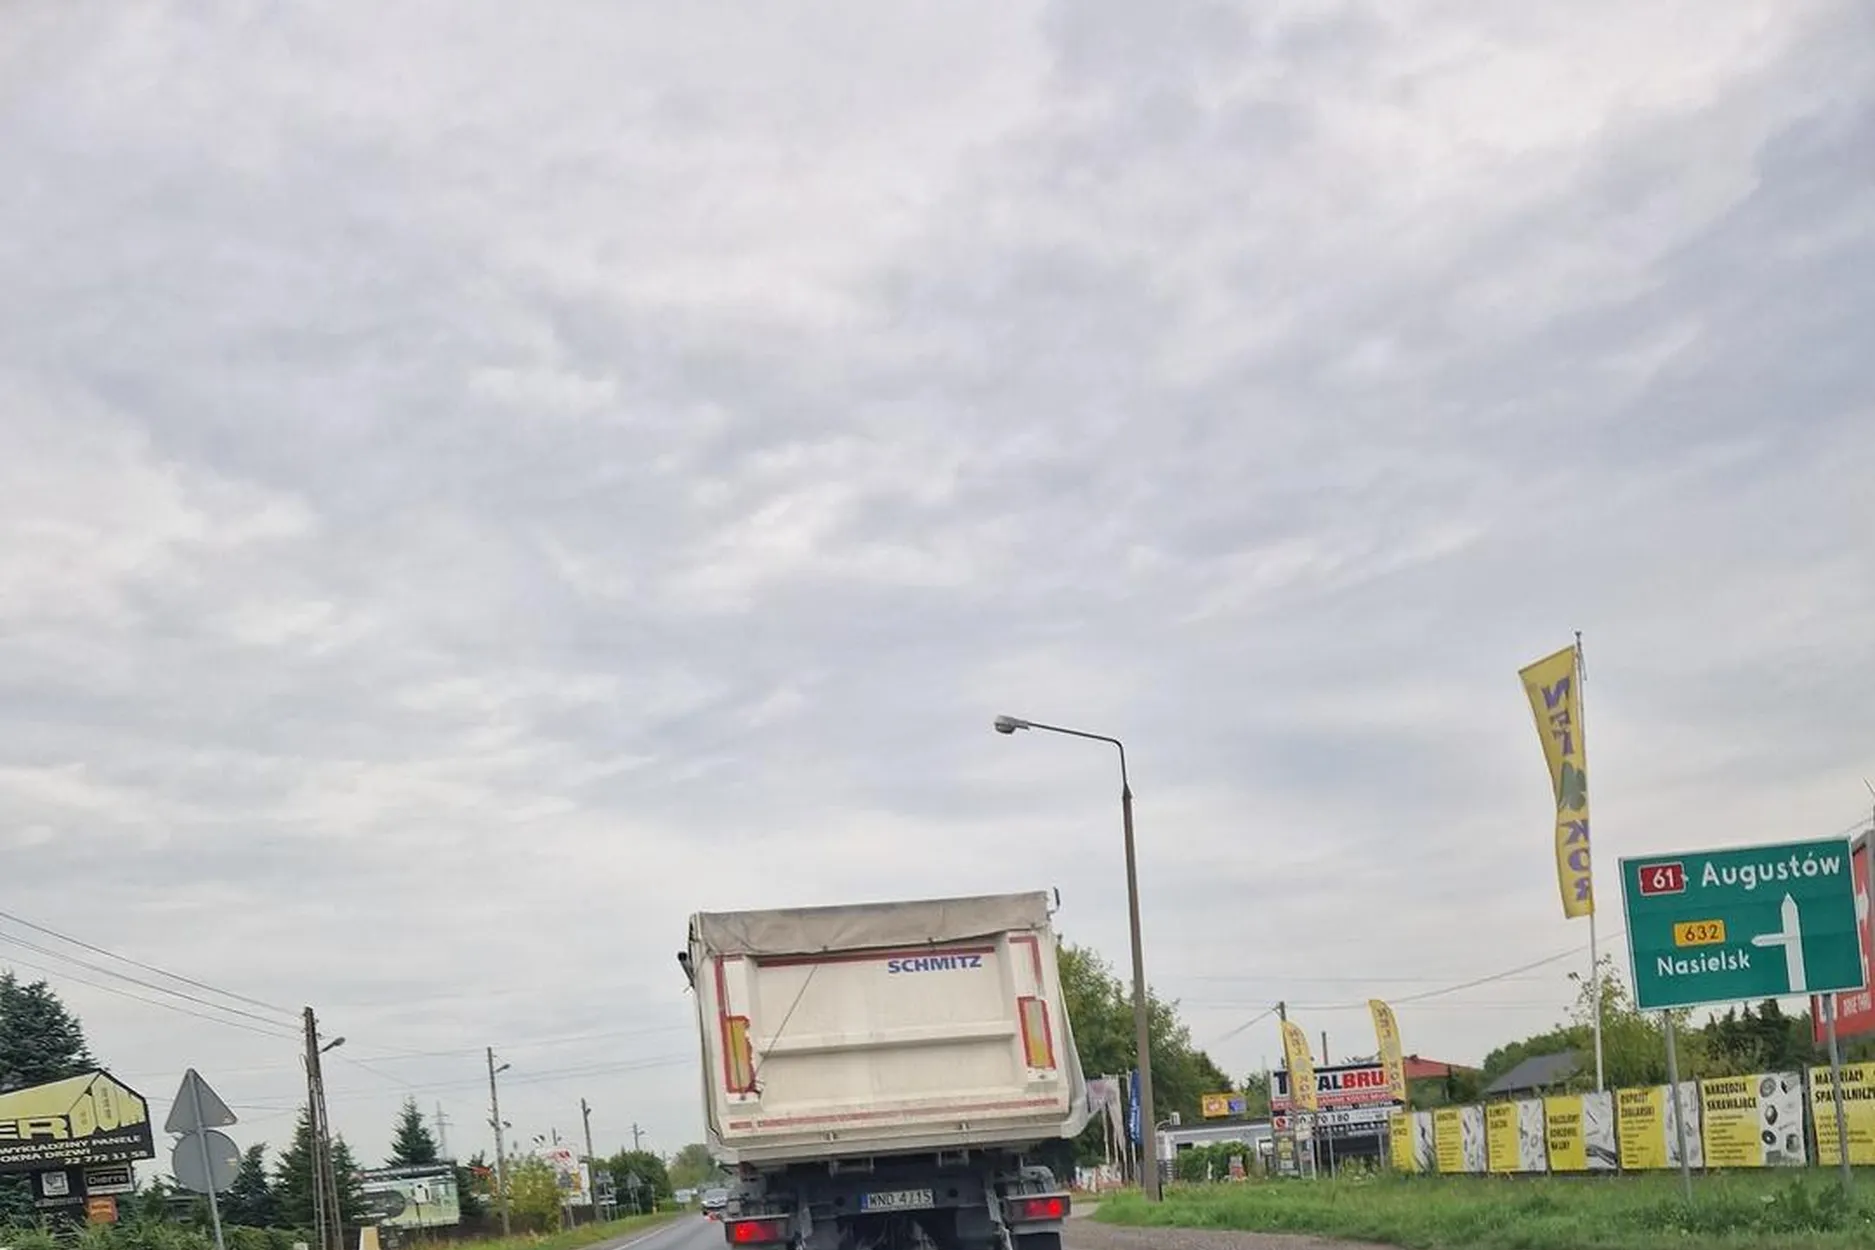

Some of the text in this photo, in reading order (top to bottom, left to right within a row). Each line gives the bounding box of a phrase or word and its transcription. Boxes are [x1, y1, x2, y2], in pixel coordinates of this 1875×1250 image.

[1652, 852, 1840, 889] 61 Augustów
[1685, 924, 1719, 942] 632
[888, 955, 982, 974] SCHMITZ
[1657, 949, 1751, 977] Nasielsk
[0, 1153, 42, 1163] OKNA
